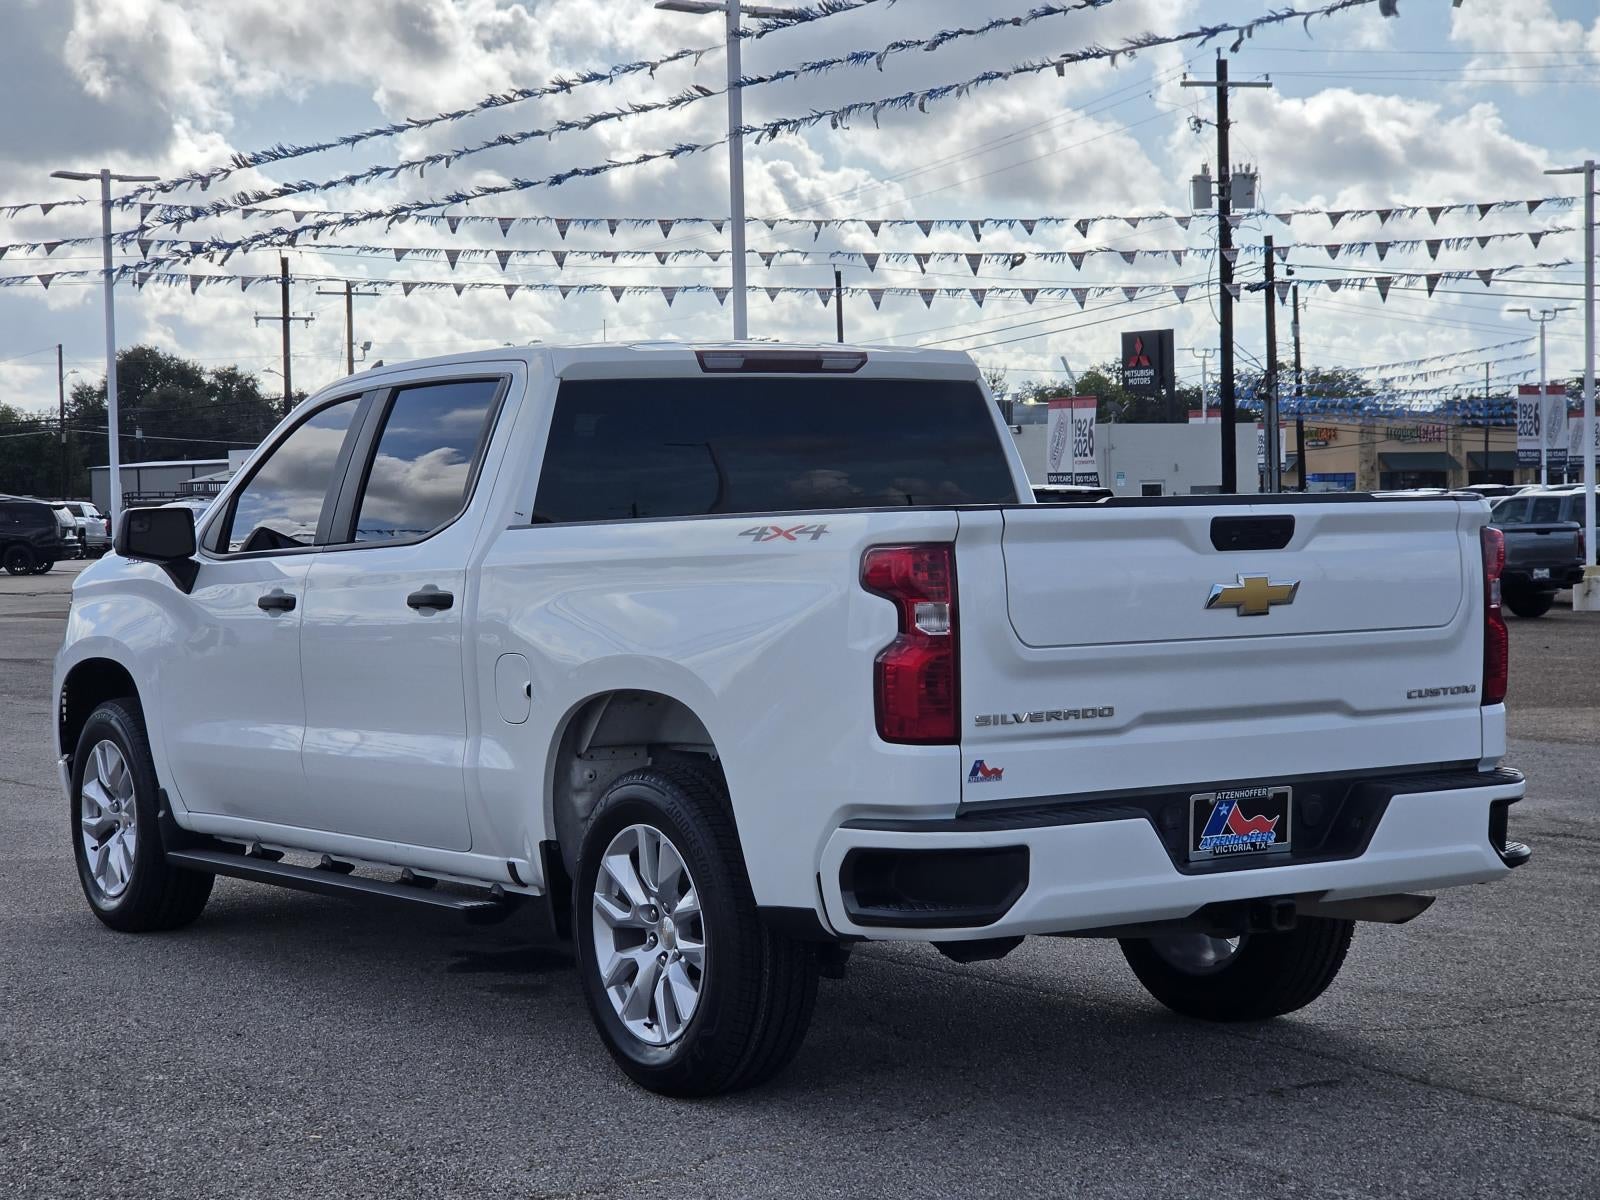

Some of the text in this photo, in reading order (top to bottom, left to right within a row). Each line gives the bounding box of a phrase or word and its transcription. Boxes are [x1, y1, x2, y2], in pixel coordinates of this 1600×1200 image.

[1124, 369, 1155, 377] MITSUBISHI
[1128, 377, 1151, 385] MOTORS
[1406, 684, 1476, 699] CUSTOM
[974, 705, 1115, 727] SILVERADO
[1216, 788, 1268, 800] ATZENHOFFER
[1200, 832, 1274, 848] ATZENHOFFER
[1214, 841, 1267, 854] VICTORIA, TX
